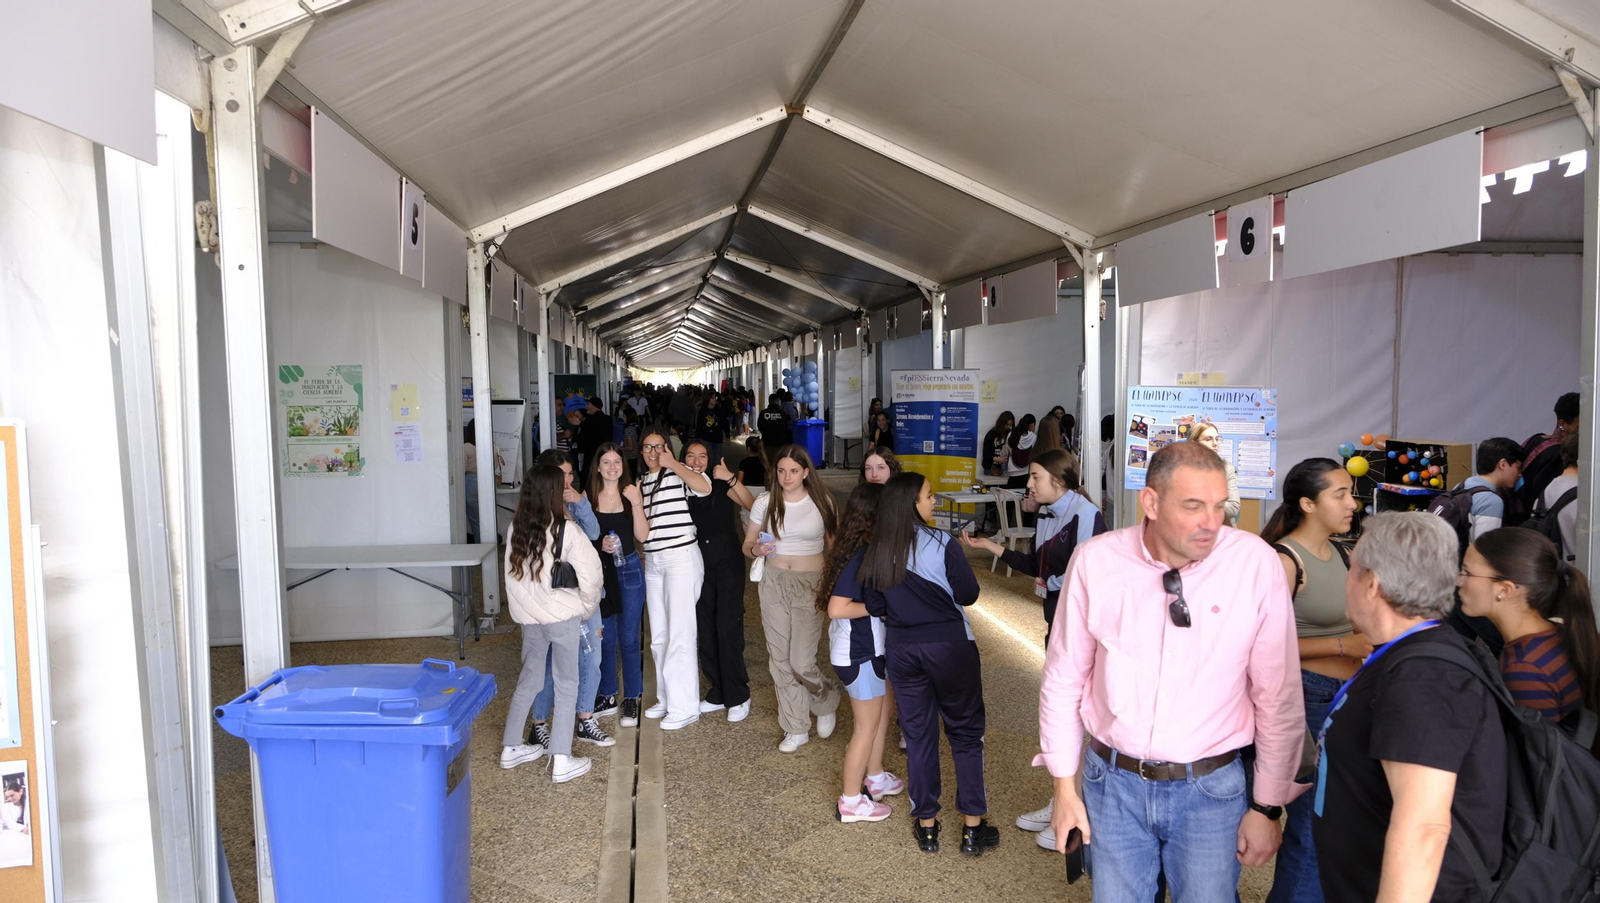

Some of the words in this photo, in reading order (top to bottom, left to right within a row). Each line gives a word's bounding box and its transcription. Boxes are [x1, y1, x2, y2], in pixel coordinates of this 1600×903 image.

[411, 202, 419, 246] 5
[1240, 216, 1255, 256] 6
[1143, 390, 1184, 401] UNIVERSO
[1213, 392, 1257, 403] UNIVERSO
